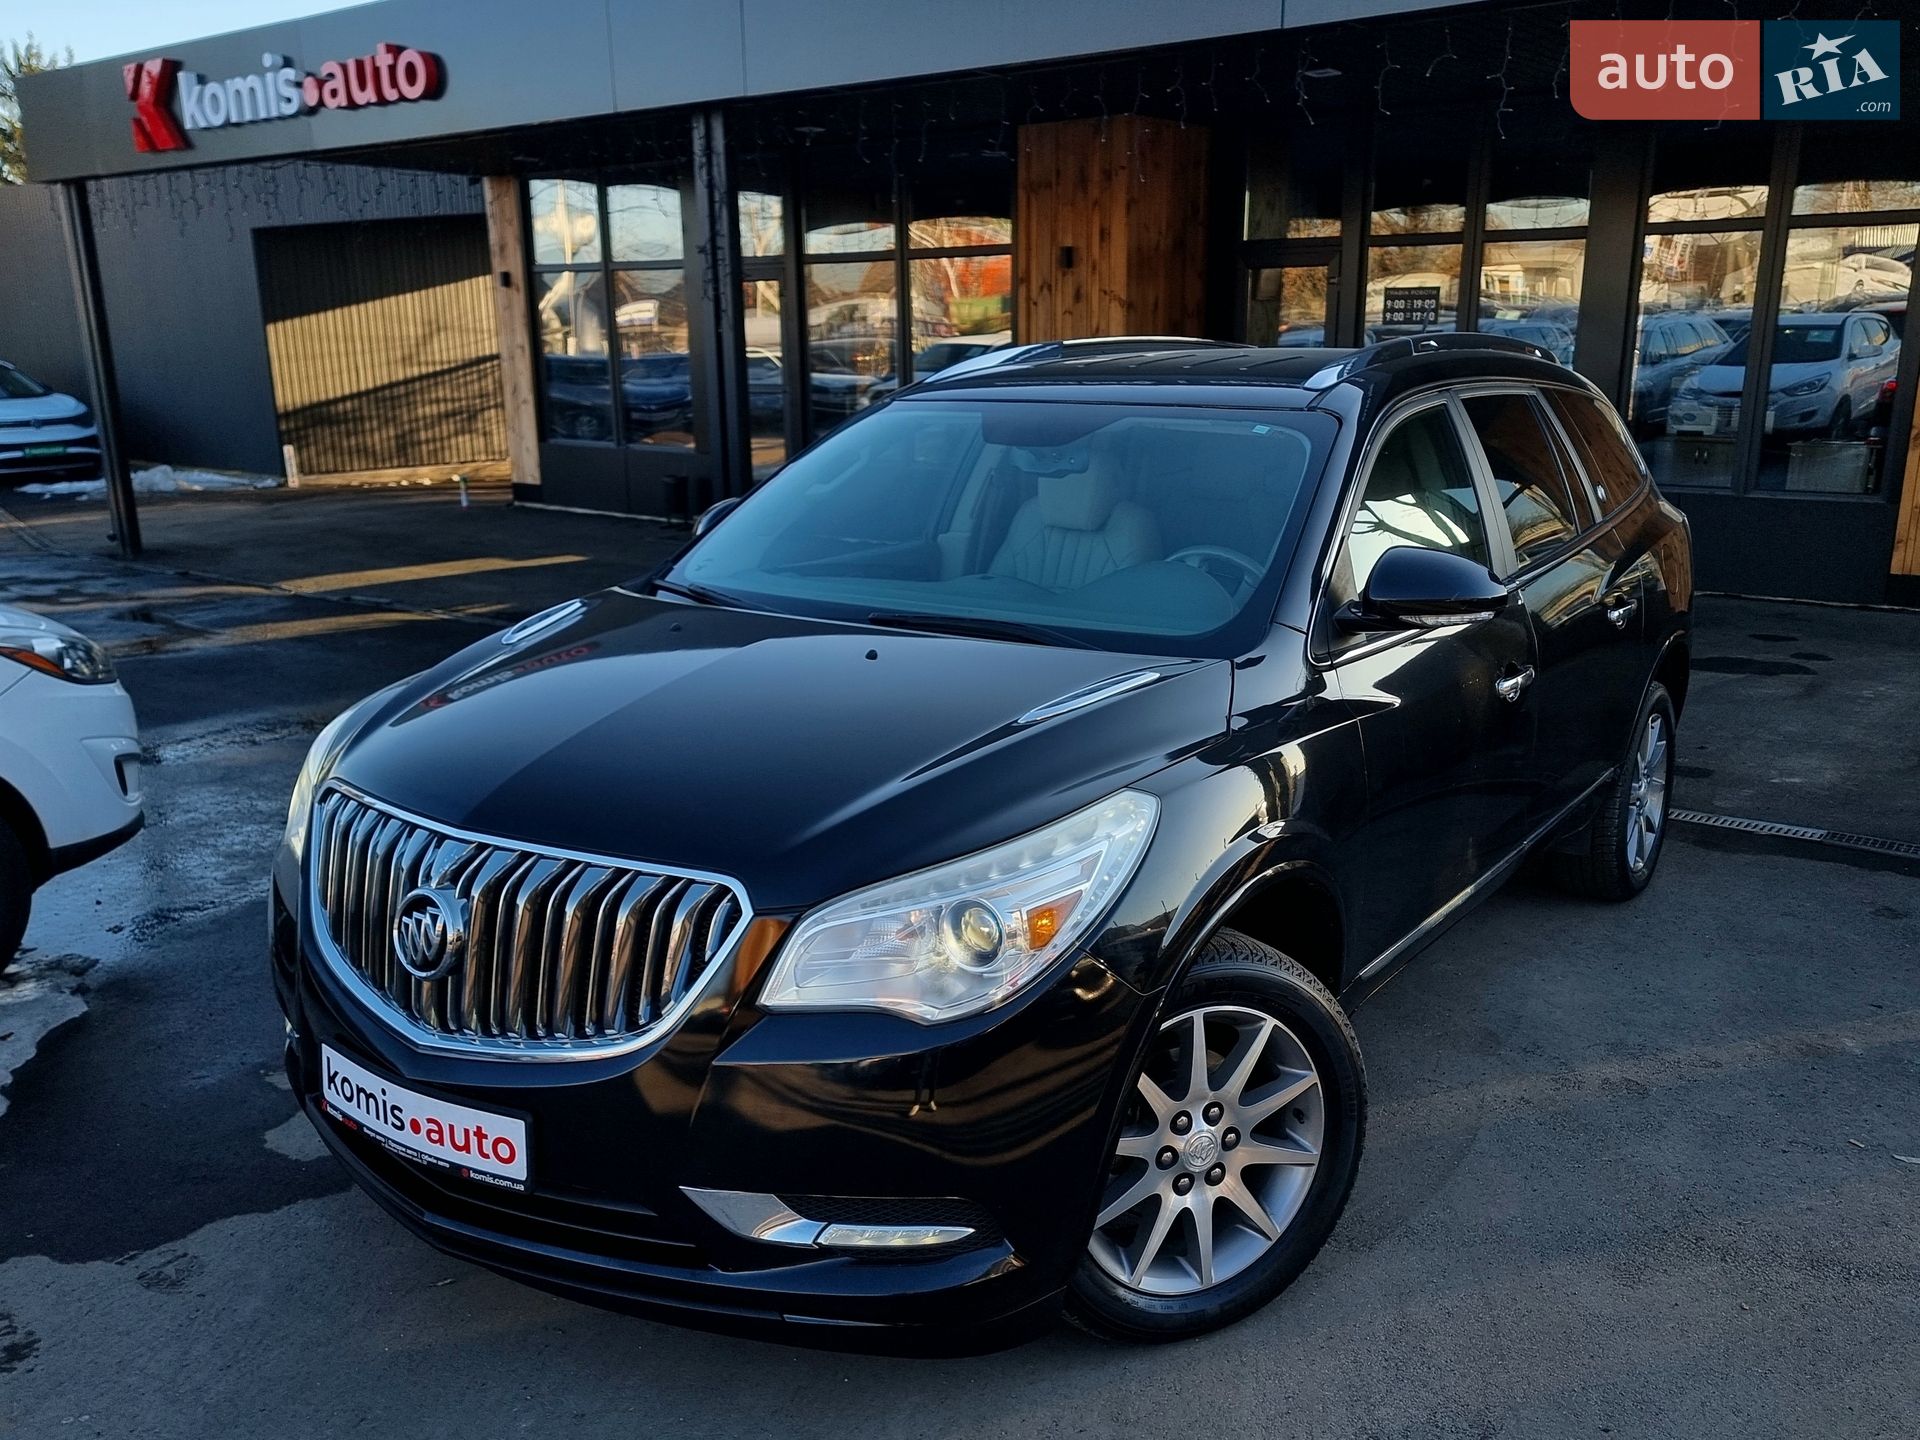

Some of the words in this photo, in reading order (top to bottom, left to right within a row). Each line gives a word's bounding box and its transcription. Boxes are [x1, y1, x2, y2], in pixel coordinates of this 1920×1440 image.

[1386, 299, 1405, 309] 9:00
[1385, 311, 1404, 321] 9:00
[469, 1170, 525, 1191] komis.com.ua
